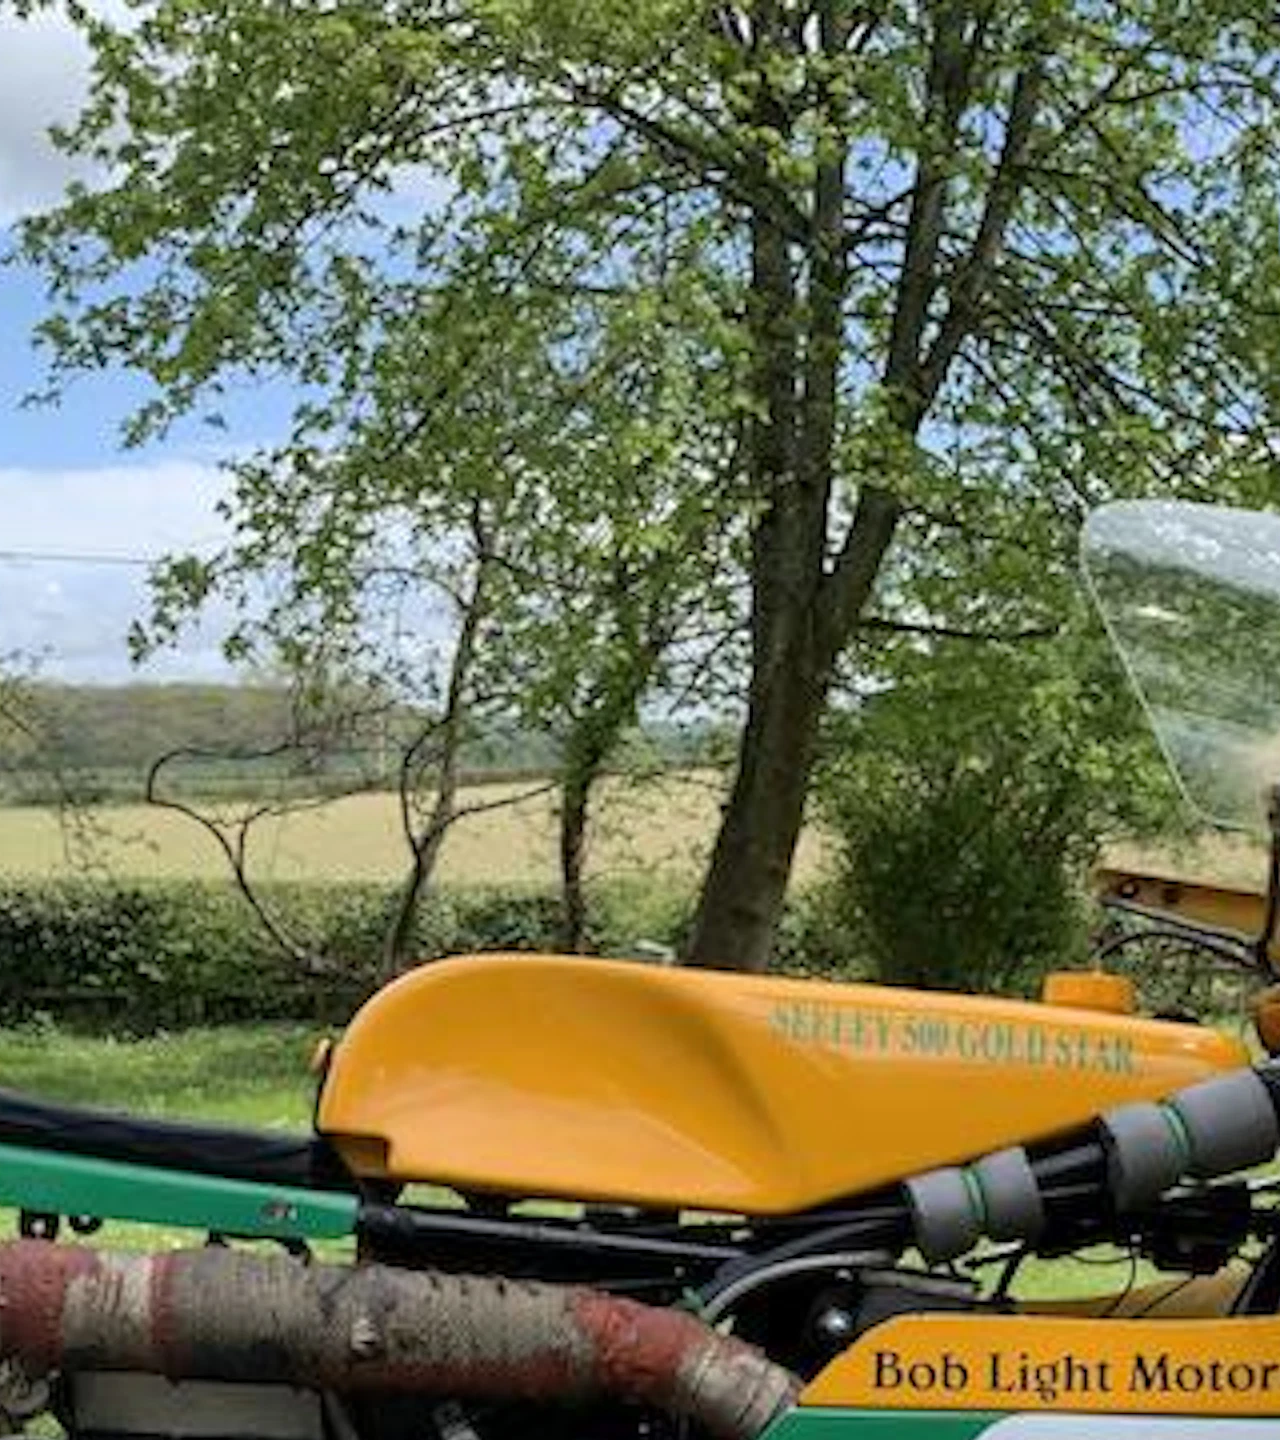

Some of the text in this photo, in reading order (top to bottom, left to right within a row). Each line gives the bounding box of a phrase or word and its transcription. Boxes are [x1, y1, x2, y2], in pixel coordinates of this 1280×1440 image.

[899, 1016, 949, 1057] 500
[956, 1022, 1045, 1066] GOLD
[1053, 1029, 1136, 1076] STAR
[873, 1350, 968, 1391] Bob
[989, 1352, 1111, 1400] Light
